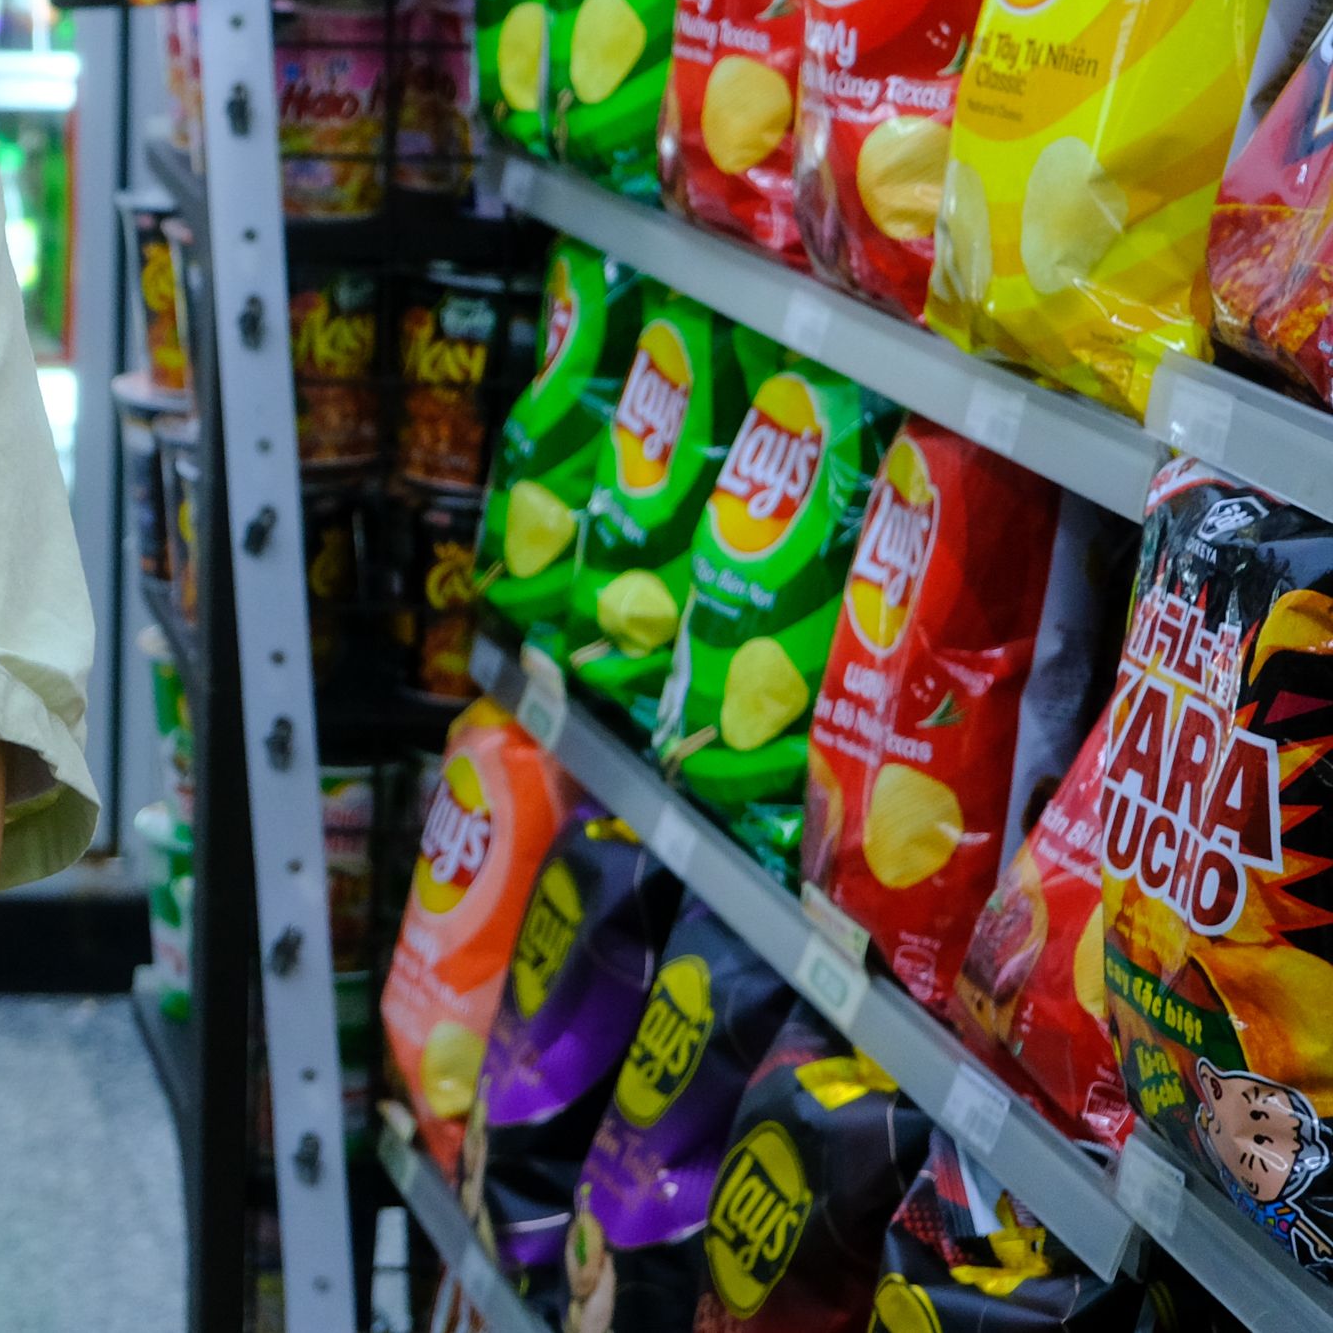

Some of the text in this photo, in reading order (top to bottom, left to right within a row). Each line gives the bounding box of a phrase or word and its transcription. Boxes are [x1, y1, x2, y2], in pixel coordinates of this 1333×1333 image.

[884, 74, 952, 110] Texas
[614, 350, 690, 460] Lay's
[716, 407, 823, 520] Lay's
[1164, 997, 1204, 1047] biệt
[715, 1152, 806, 1267] Lay's
